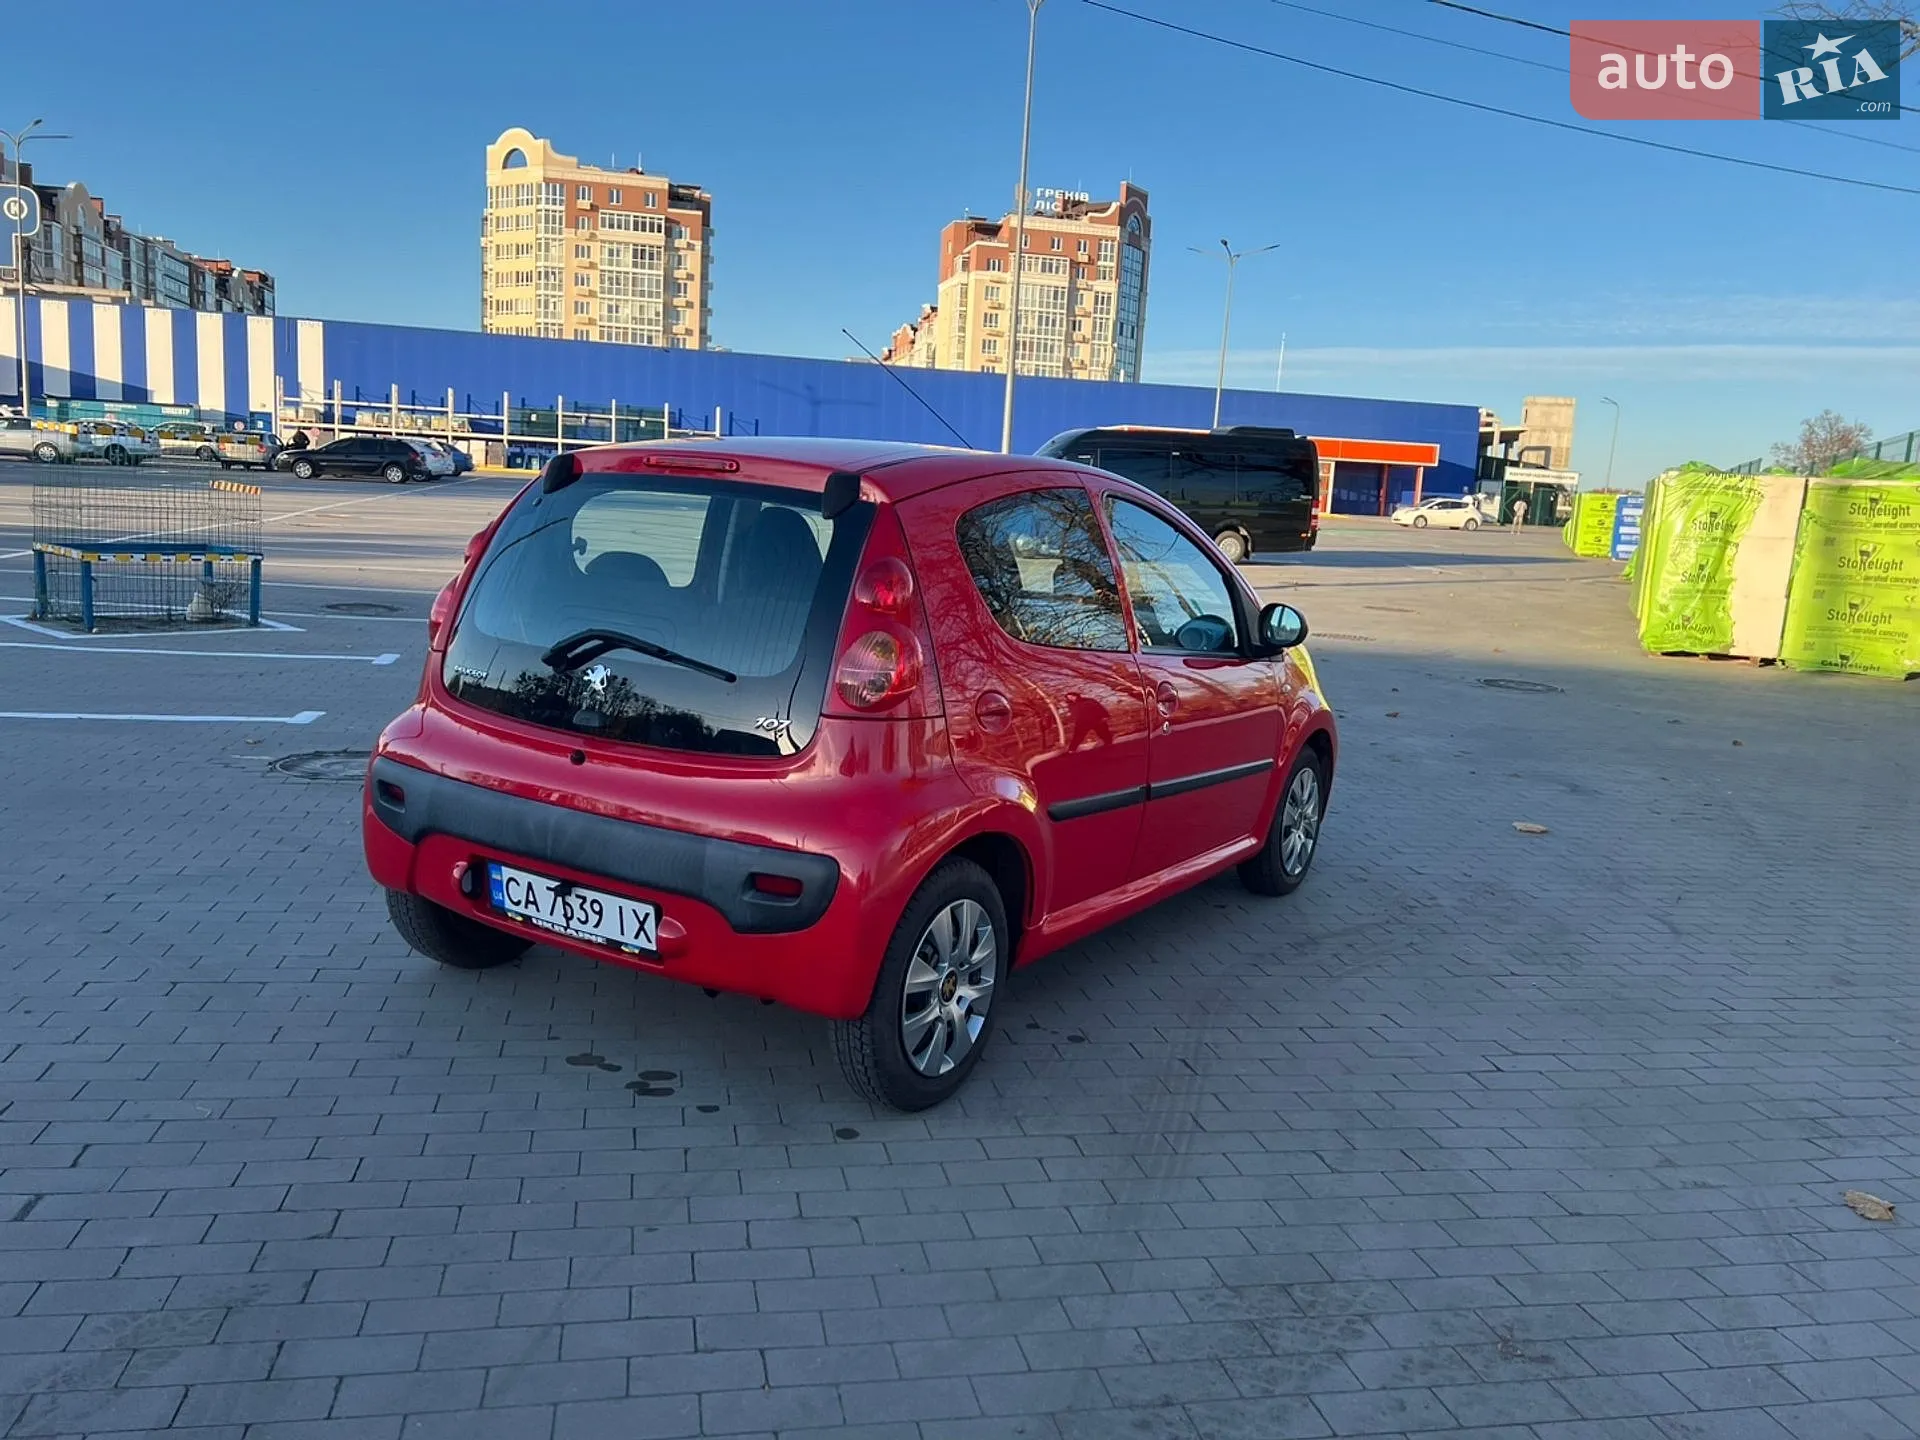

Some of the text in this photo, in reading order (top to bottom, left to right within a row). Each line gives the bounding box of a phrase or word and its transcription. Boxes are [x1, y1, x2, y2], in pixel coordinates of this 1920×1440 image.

[754, 717, 793, 731] 107
[505, 876, 541, 913] CA
[618, 905, 652, 944] IX
